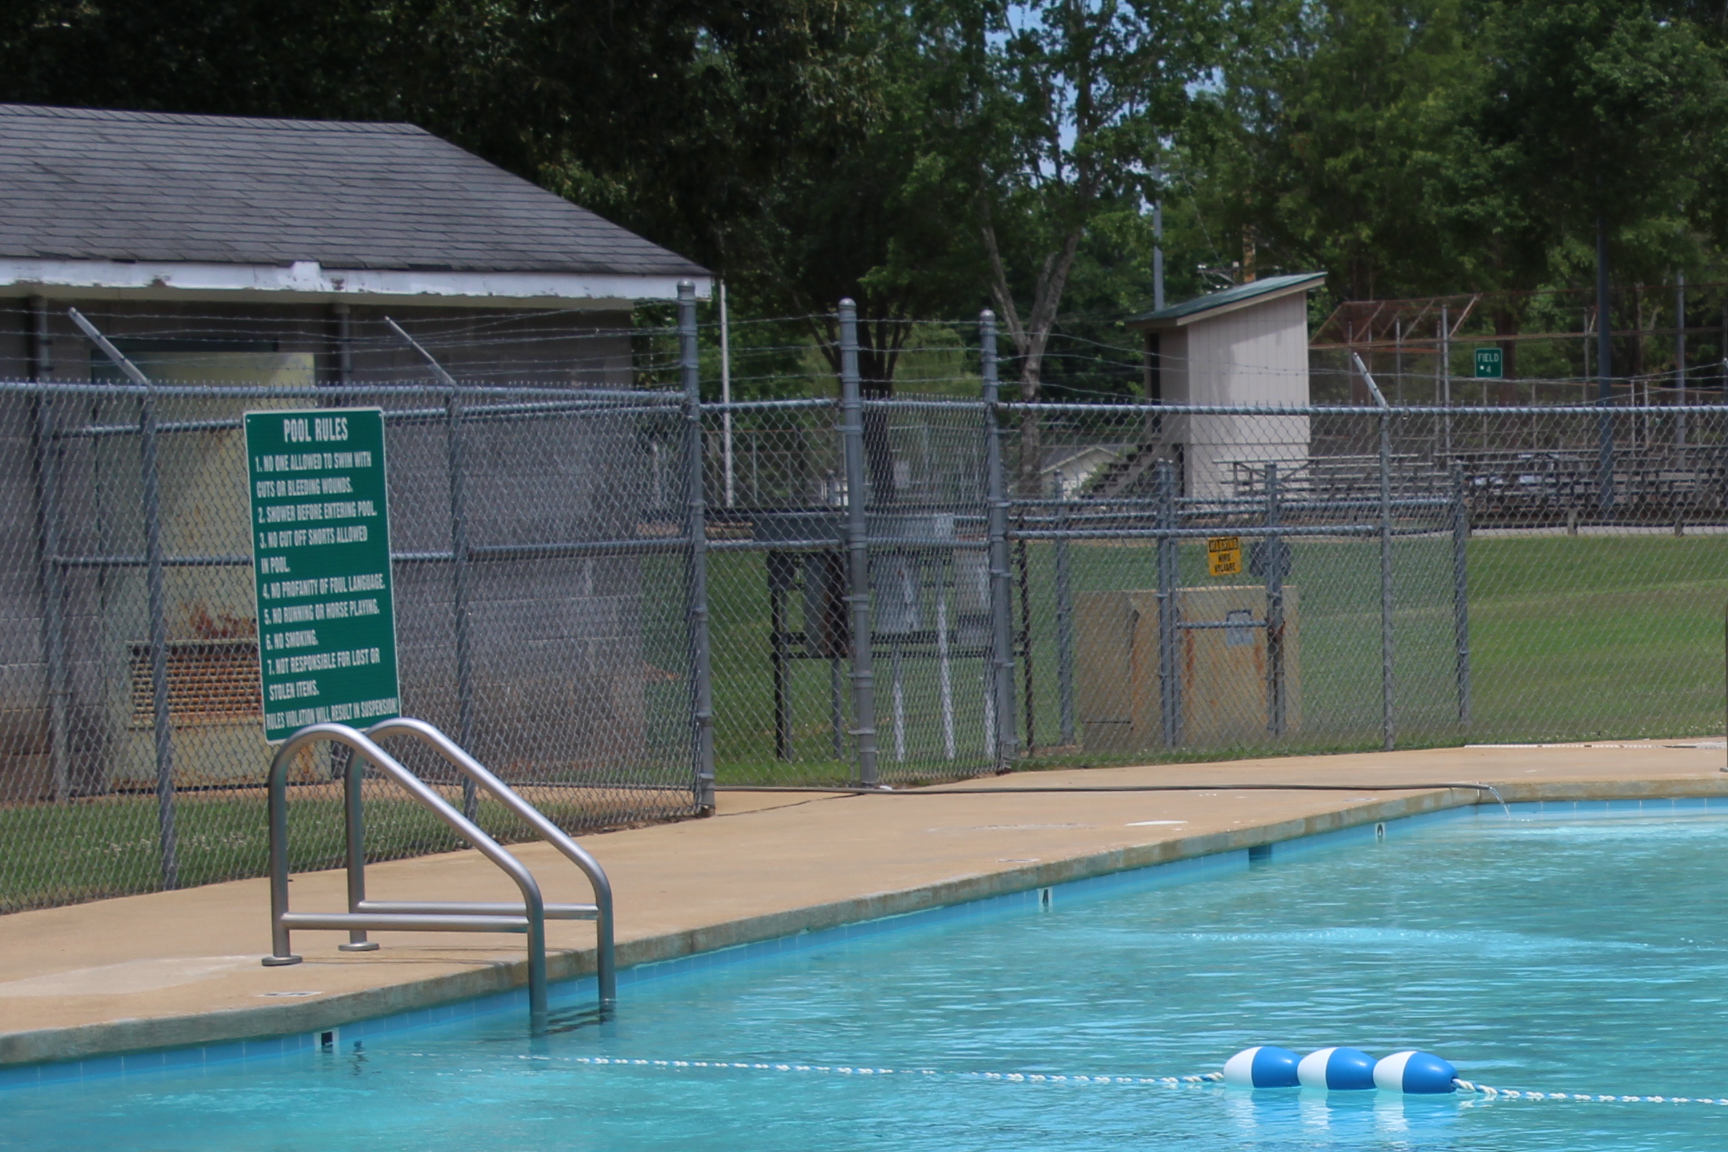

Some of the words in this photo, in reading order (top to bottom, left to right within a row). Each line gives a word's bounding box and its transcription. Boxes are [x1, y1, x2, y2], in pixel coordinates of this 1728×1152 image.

[1478, 353, 1499, 363] FIELD
[1486, 365, 1491, 373] 4
[284, 418, 312, 442] POOL
[314, 417, 348, 441] RULES
[255, 456, 262, 472] 1.
[263, 455, 273, 471] NO
[275, 455, 288, 471] ONE
[290, 454, 322, 470] ALLOWED
[323, 453, 332, 469] TO
[334, 452, 353, 468] SWIM
[354, 452, 372, 467] WITH
[257, 481, 275, 498] CUTS
[276, 480, 286, 497] OR
[287, 479, 320, 496] BLEEDING
[321, 477, 353, 494] WOUNDS.
[258, 507, 265, 523] 2.
[267, 505, 295, 522] SHOWER
[297, 504, 323, 521] BEFORE
[324, 502, 356, 519] ENTERING
[358, 501, 377, 516] POOL.
[260, 532, 267, 549] 3.
[268, 532, 277, 548] NO
[279, 531, 292, 547] CUT
[294, 530, 306, 546] OFF
[308, 528, 335, 545] SHORTS
[336, 526, 368, 543] ALLOWED
[261, 558, 269, 574] IN
[270, 557, 290, 573] POOL.
[263, 583, 270, 599] 4.
[271, 582, 280, 599] NO
[282, 580, 318, 598] PROFANITY
[330, 577, 347, 593] FOUL
[348, 574, 385, 592] LANGUAGE.
[264, 609, 271, 625] 5.
[272, 608, 282, 624] NO
[284, 605, 314, 623] RUNNING
[315, 604, 325, 620] OR
[326, 601, 348, 619] HORSE
[349, 599, 380, 617] PLAYING.
[266, 634, 273, 650] 6.
[274, 633, 284, 649] NO
[285, 630, 318, 648] SMOKING.
[267, 660, 275, 675] 7.
[276, 658, 289, 674] NOT
[290, 652, 336, 673] RESPONSIBLE
[338, 651, 350, 668] FOR
[352, 649, 369, 666] LOST
[370, 648, 380, 664] OR
[269, 683, 295, 701] STOLEN
[296, 680, 320, 698] ITEMS.
[267, 713, 285, 730] RULES
[285, 709, 315, 728] VIOLATION
[316, 706, 330, 723] WILL
[331, 703, 352, 721] RESULT
[353, 702, 360, 718] IN
